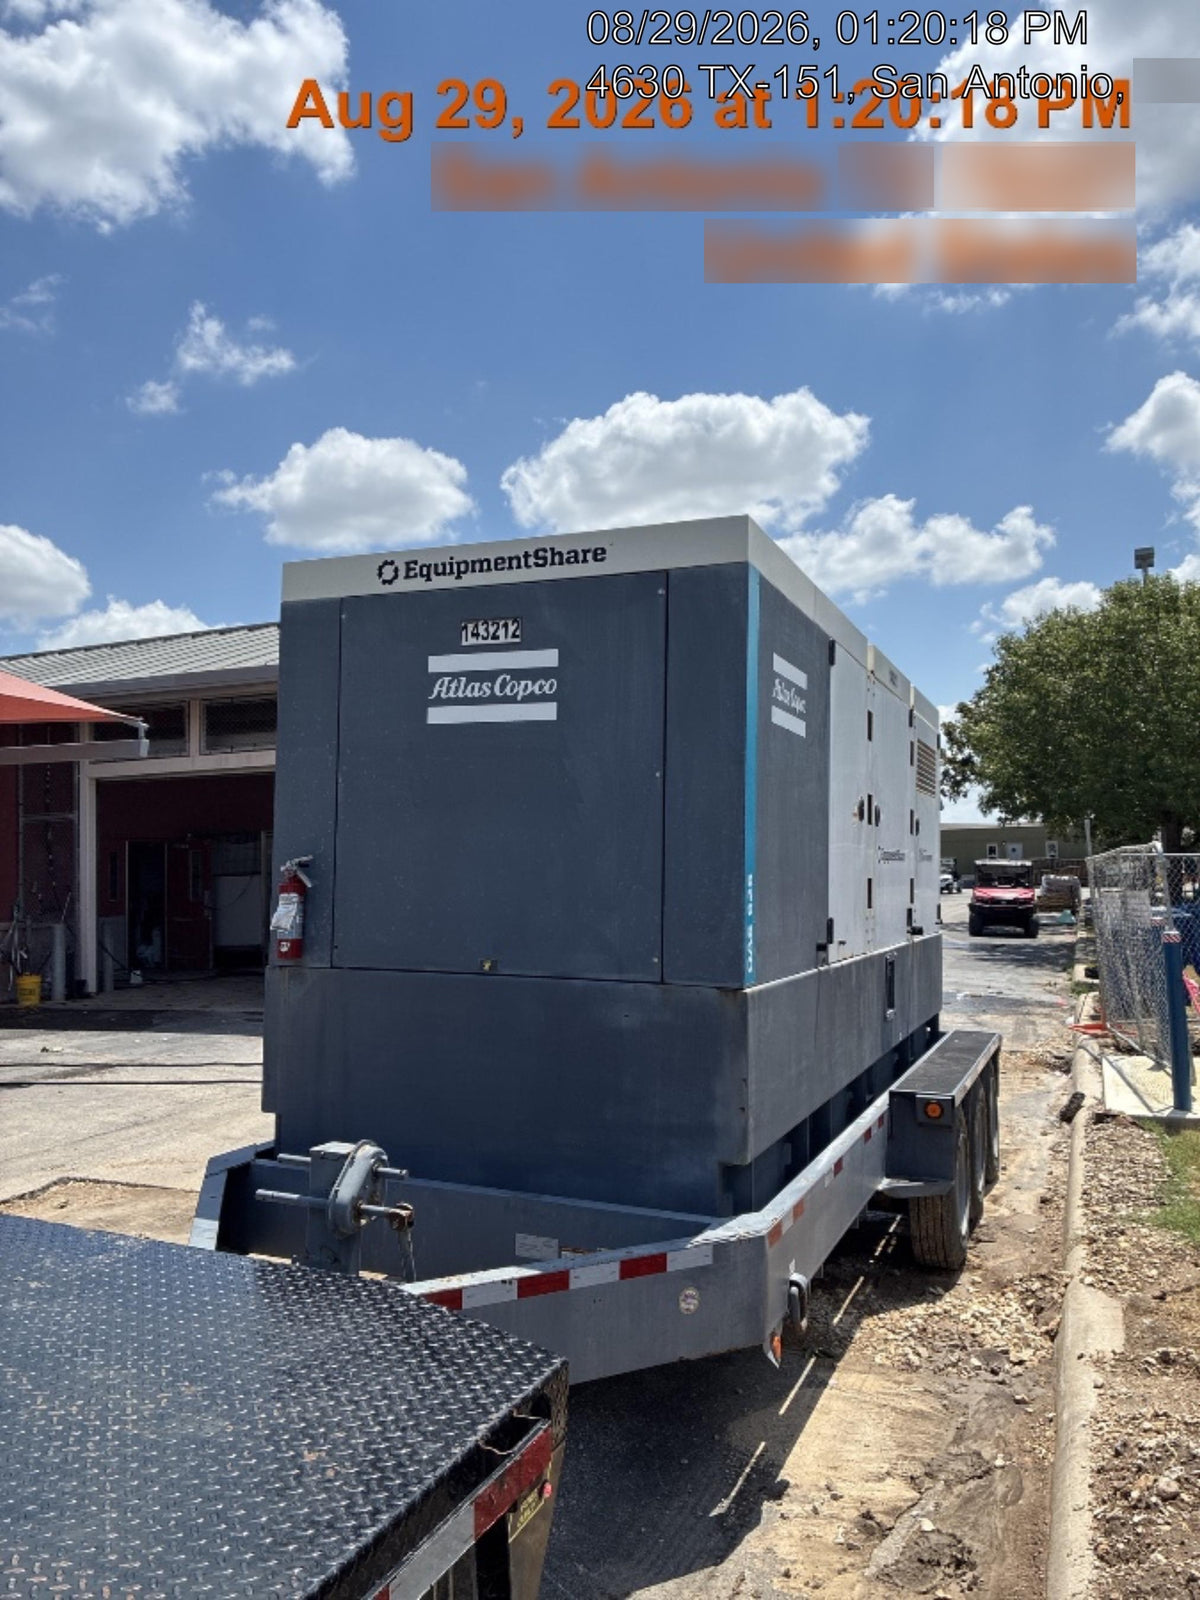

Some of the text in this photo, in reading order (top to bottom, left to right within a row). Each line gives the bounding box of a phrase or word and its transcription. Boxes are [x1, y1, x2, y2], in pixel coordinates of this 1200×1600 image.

[403, 547, 607, 582] EquipmentShare
[461, 618, 521, 643] 143212
[428, 674, 558, 701] Atlas Copco
